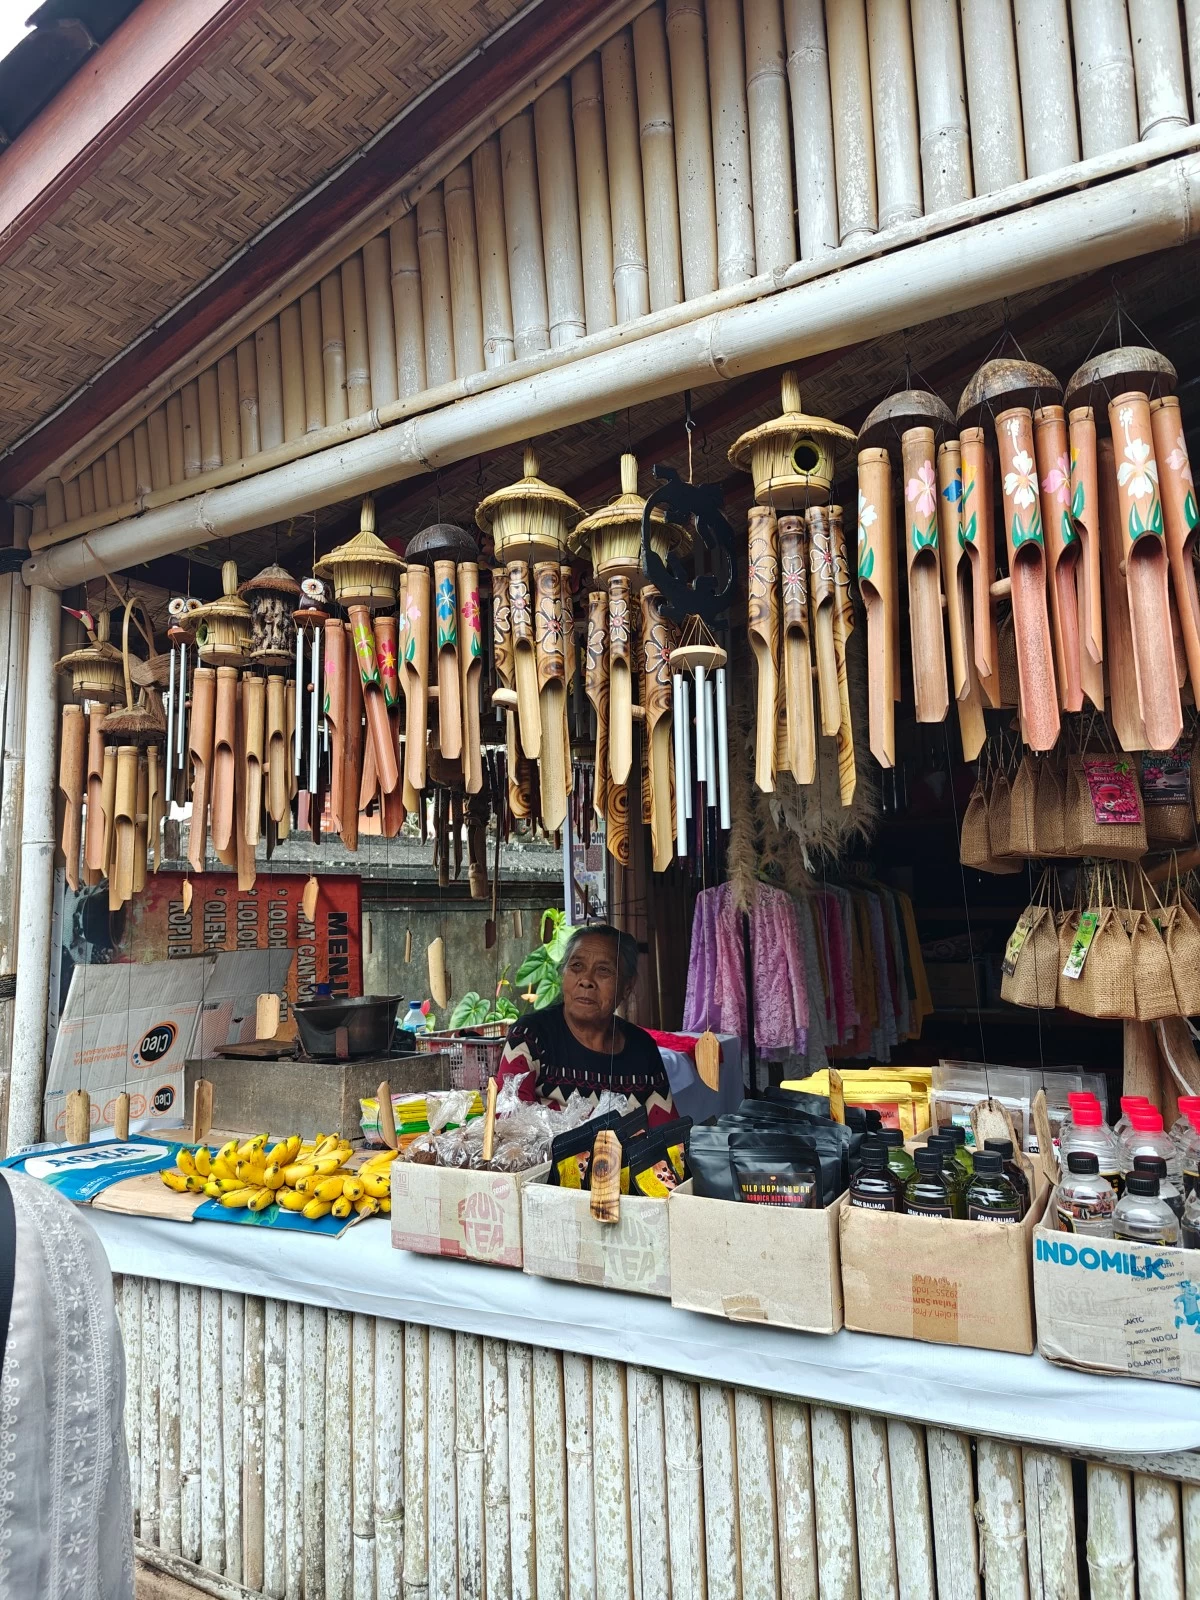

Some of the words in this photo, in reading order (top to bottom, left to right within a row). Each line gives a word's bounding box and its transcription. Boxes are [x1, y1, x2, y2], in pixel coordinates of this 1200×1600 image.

[168, 901, 192, 940] KOPI
[237, 900, 258, 950] LOLOH
[268, 900, 288, 949] LOLOH
[141, 1033, 169, 1053] Cleo
[154, 1093, 171, 1106] Cleo
[46, 1147, 146, 1168] AQUA
[741, 1184, 758, 1193] WILD
[457, 1191, 506, 1224] FRUIT
[863, 1202, 886, 1210] BALIAGA
[977, 1214, 993, 1222] ARAK
[458, 1220, 505, 1253] TEA
[602, 1246, 656, 1281] TEA
[1036, 1239, 1165, 1280] INDOMILK
[932, 1299, 957, 1309] Pulau
[934, 1309, 952, 1320] oleh
